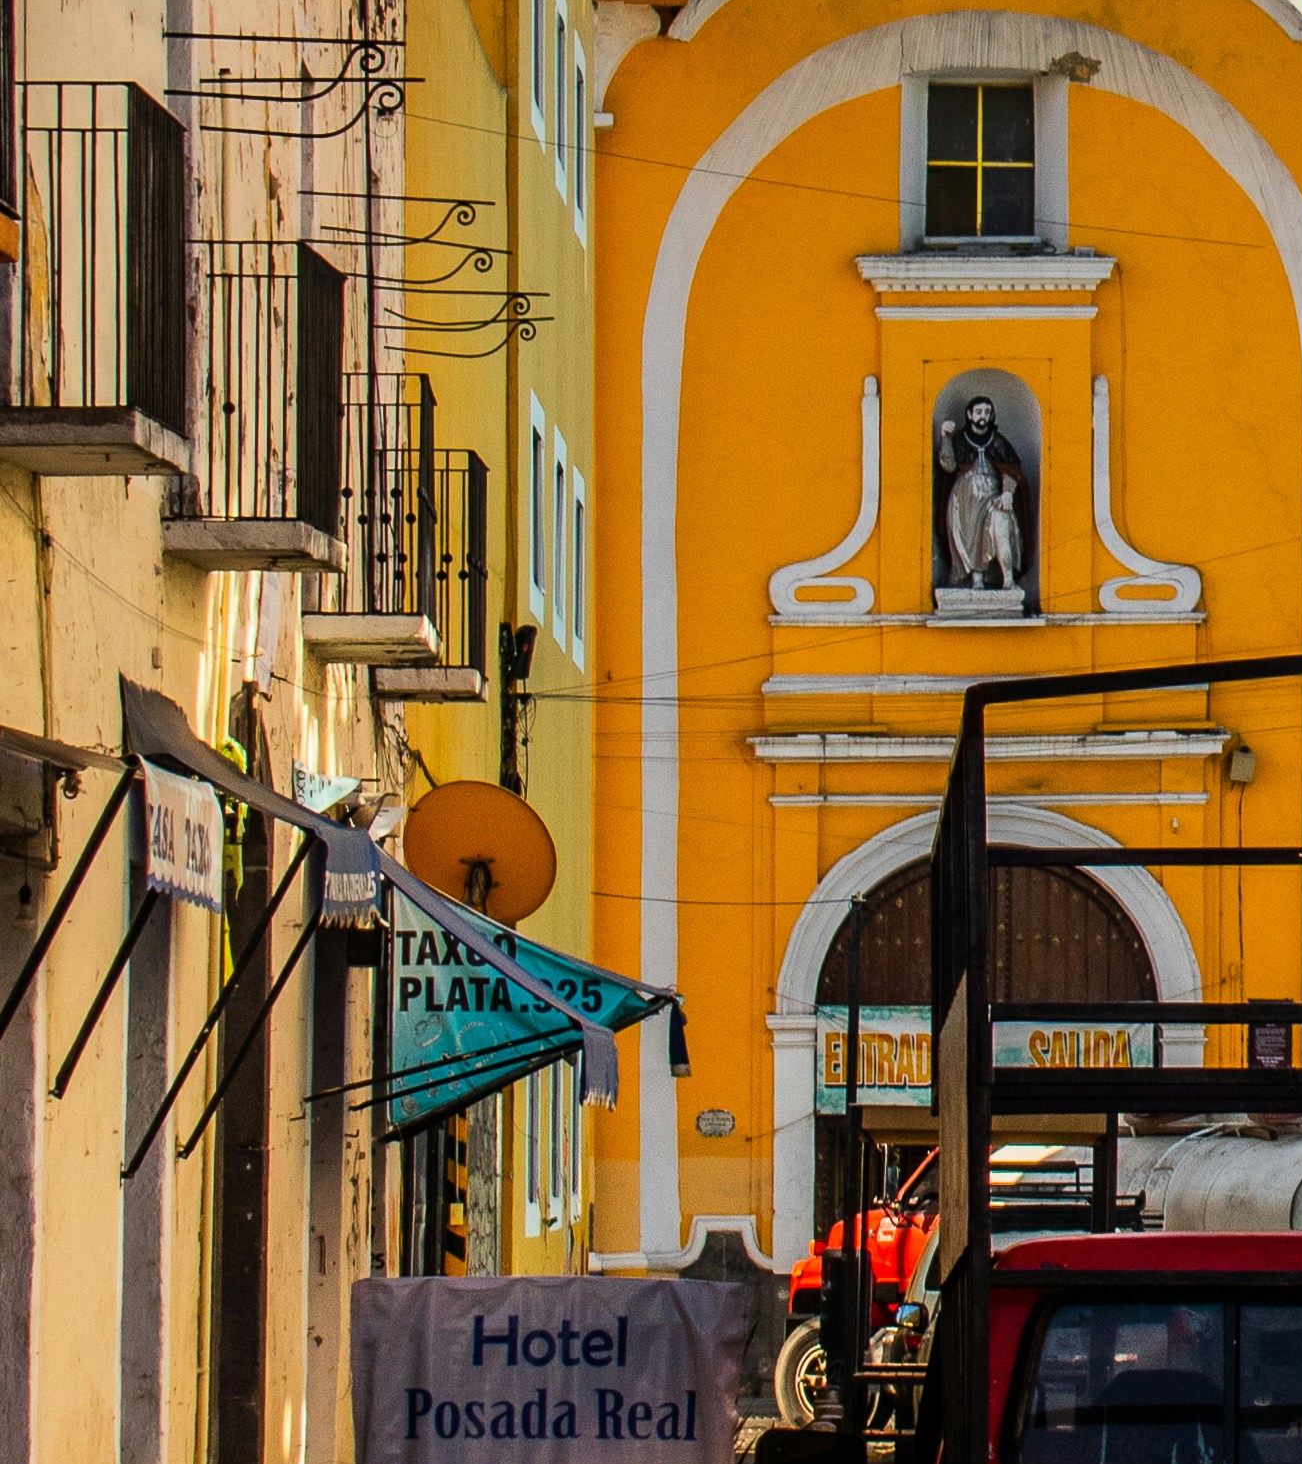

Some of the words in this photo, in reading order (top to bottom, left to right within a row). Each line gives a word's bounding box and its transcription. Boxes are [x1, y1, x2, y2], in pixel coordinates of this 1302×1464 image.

[148, 803, 175, 866] ASA
[400, 977, 513, 1013] PLATA
[824, 1031, 932, 1087] ETRAD
[472, 1314, 629, 1367] Hotel
[404, 1388, 581, 1440] Posada
[594, 1388, 698, 1442] Real
